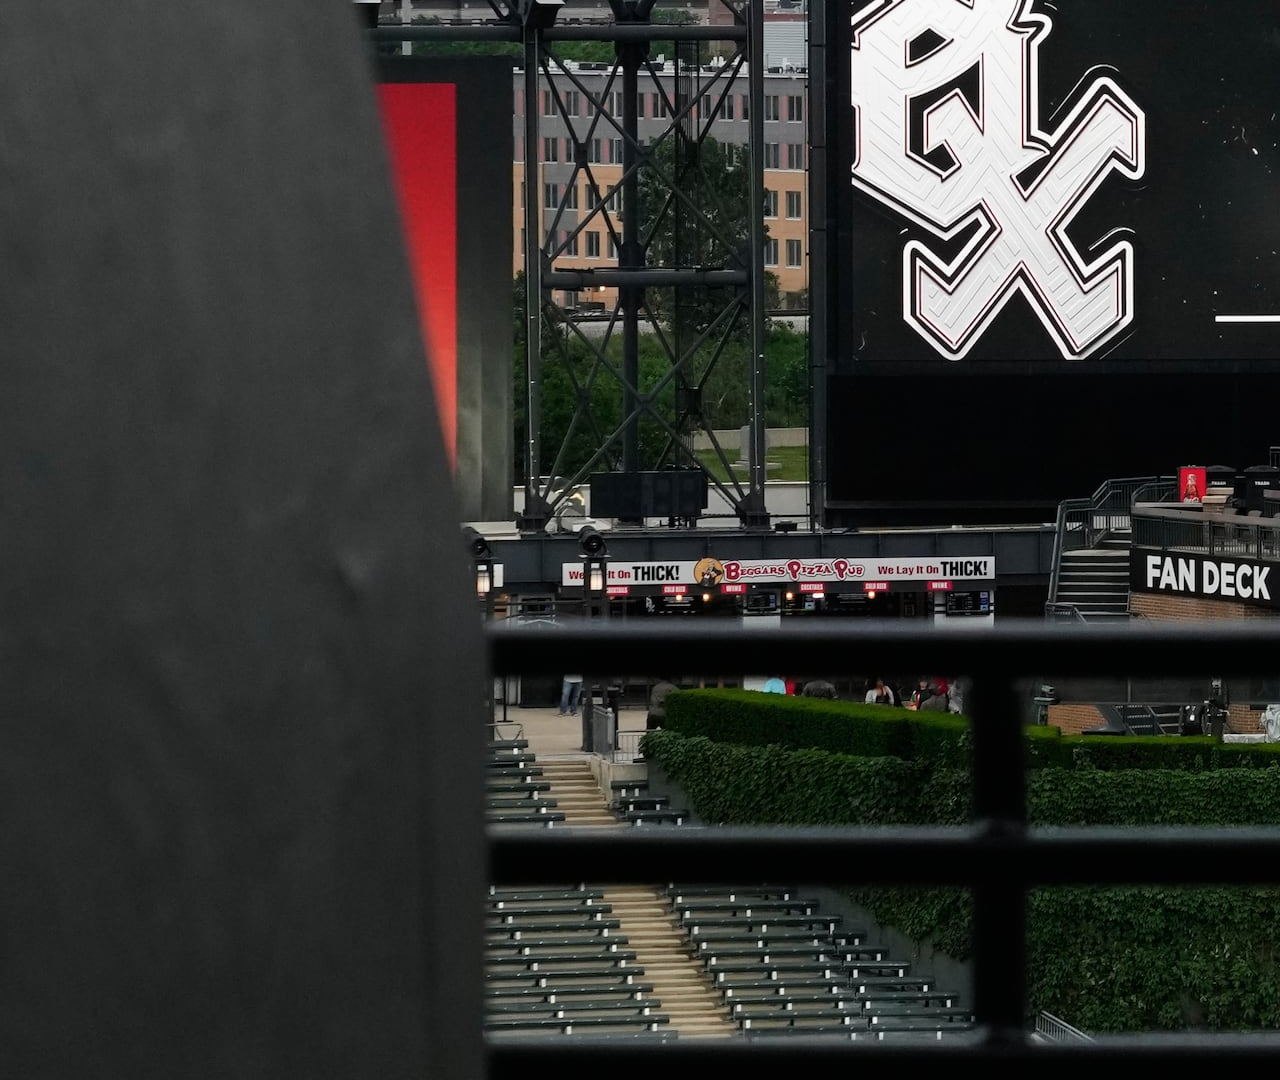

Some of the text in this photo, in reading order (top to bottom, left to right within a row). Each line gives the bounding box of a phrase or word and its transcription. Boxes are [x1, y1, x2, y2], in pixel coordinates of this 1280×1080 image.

[618, 570, 631, 578] On
[632, 565, 680, 581] THICK!
[724, 559, 864, 580] BEGGARS PIZZA PUB
[878, 560, 988, 577] We Lay It On THICK!
[1146, 555, 1271, 600] FAN DECK
